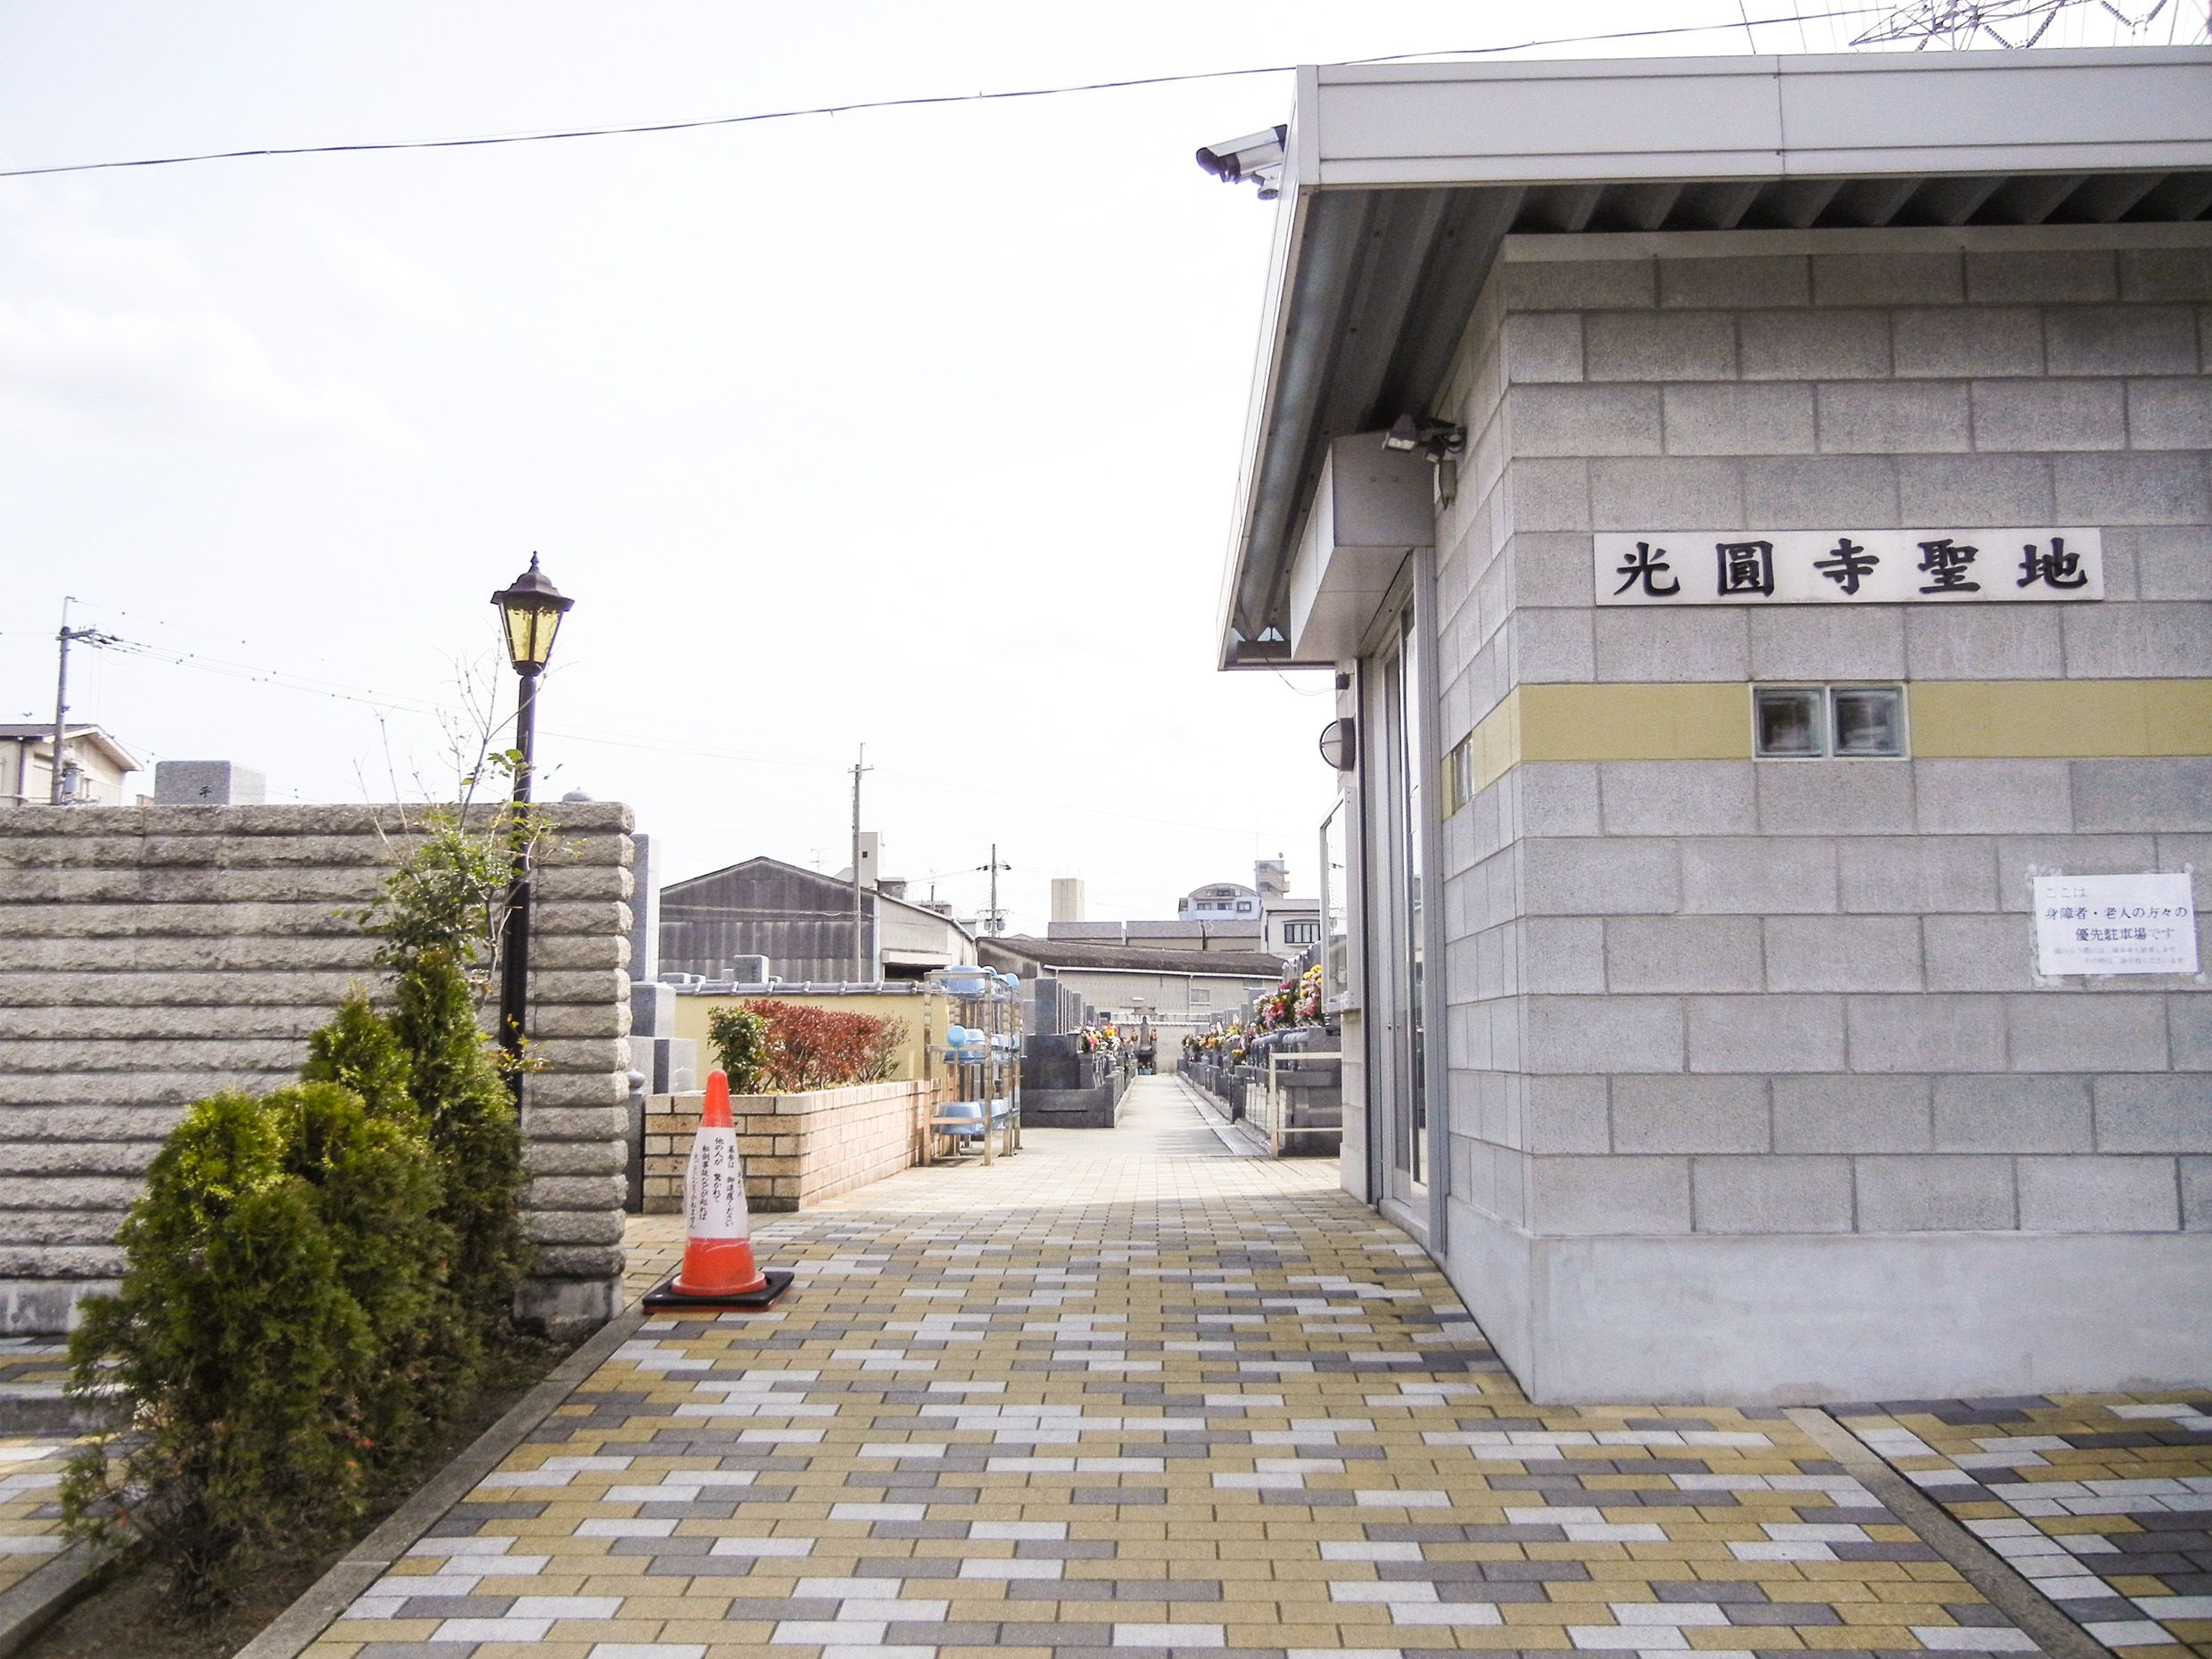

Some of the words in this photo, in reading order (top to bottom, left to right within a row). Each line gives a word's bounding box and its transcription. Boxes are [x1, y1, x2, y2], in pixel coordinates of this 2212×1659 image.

[1614, 537, 2088, 597] 光圓寺聖地
[2044, 886, 2087, 899] ここは
[2044, 906, 2188, 920] 身障者・老人の方々の
[2076, 928, 2175, 942] 優先駐車場です
